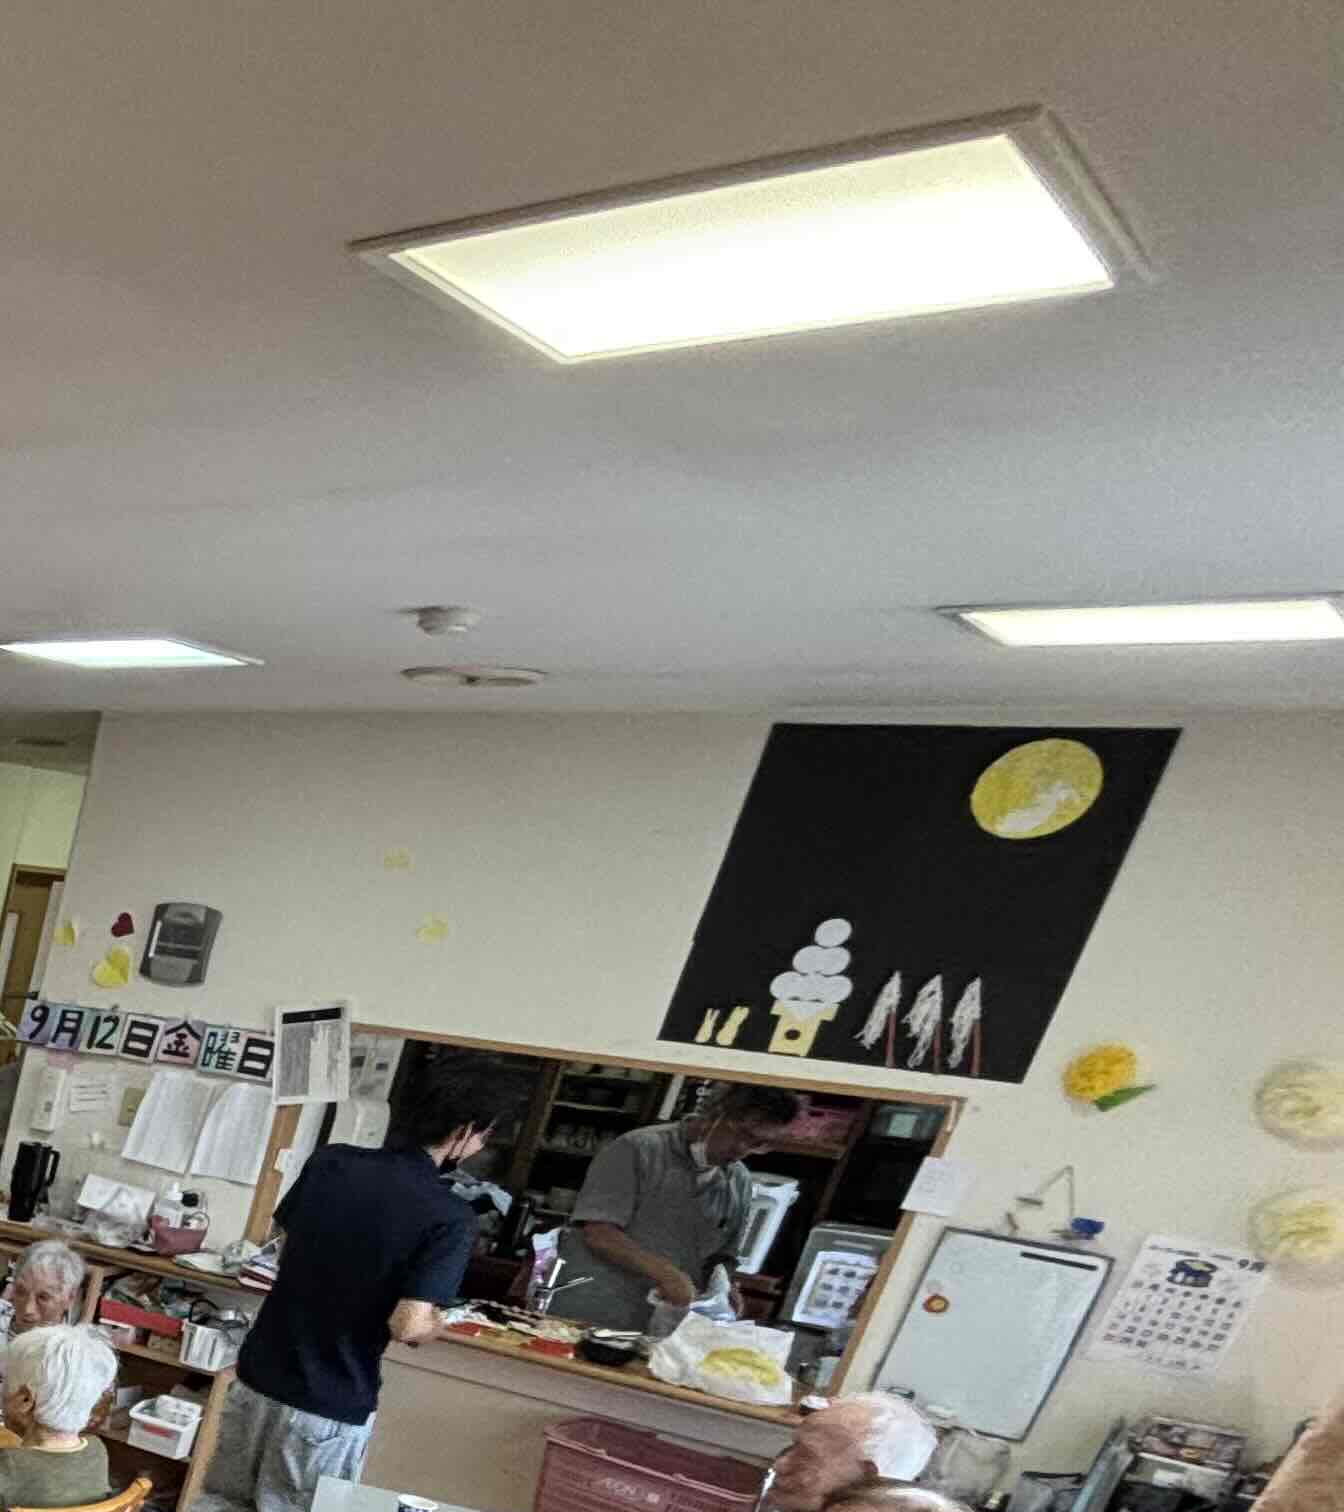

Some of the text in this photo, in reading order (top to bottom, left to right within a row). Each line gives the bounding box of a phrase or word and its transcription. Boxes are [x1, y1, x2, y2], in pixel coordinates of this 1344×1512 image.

[29, 1004, 275, 1078] 9月12日金曜日
